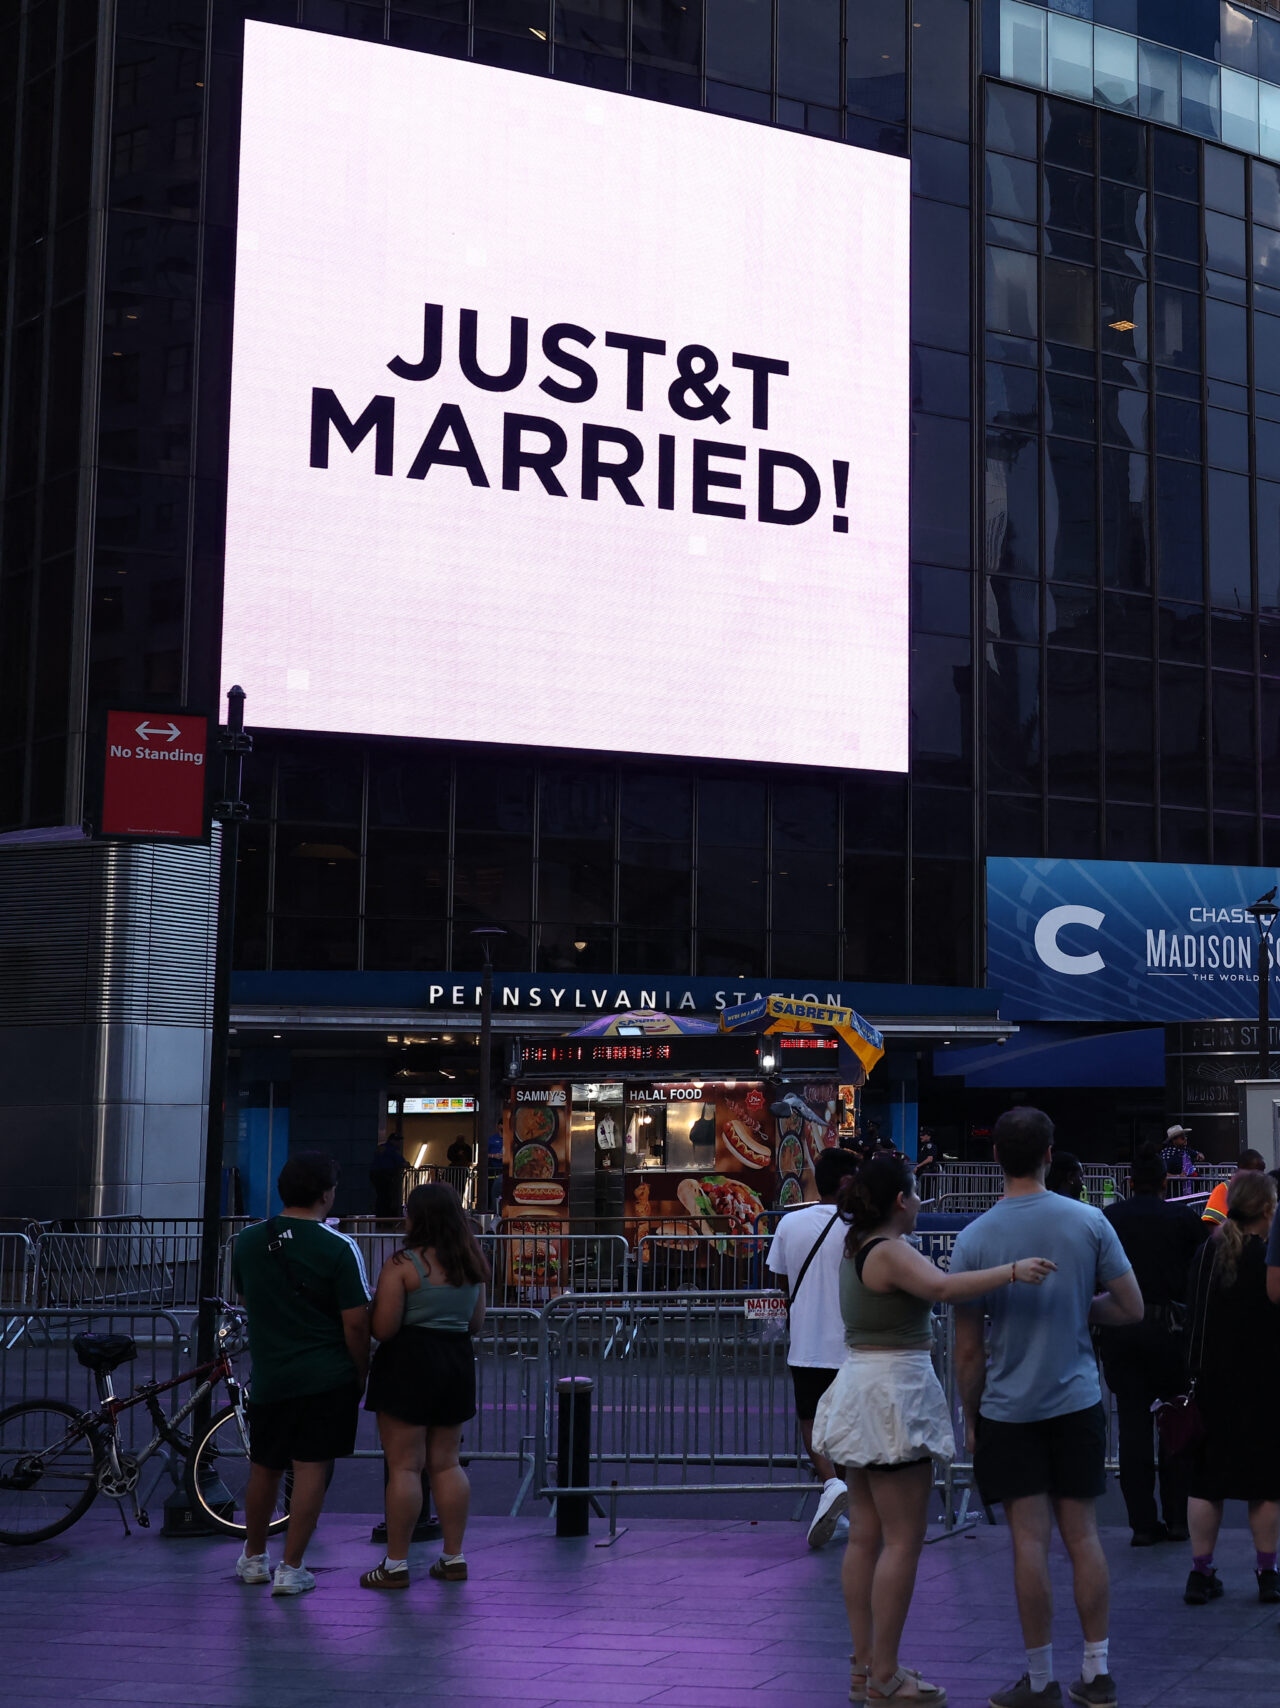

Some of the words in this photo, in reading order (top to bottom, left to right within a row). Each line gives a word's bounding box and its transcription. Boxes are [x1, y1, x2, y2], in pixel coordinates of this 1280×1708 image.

[386, 302, 790, 431] JUST&T
[309, 386, 850, 534] MARRIED!
[110, 745, 132, 758] No
[135, 746, 204, 765] Standing
[1189, 907, 1257, 924] CHASE
[1034, 904, 1106, 975] C
[1146, 928, 1252, 969] MADISON
[1192, 973, 1215, 982] THE
[1219, 974, 1272, 983] WORLD
[715, 991, 841, 1010] STION
[773, 1001, 848, 1023] SABRETT
[516, 1090, 567, 1103] SAMMY'S
[630, 1089, 667, 1101] HALAL
[670, 1088, 703, 1100] FOOD
[747, 1298, 787, 1310] NATION
